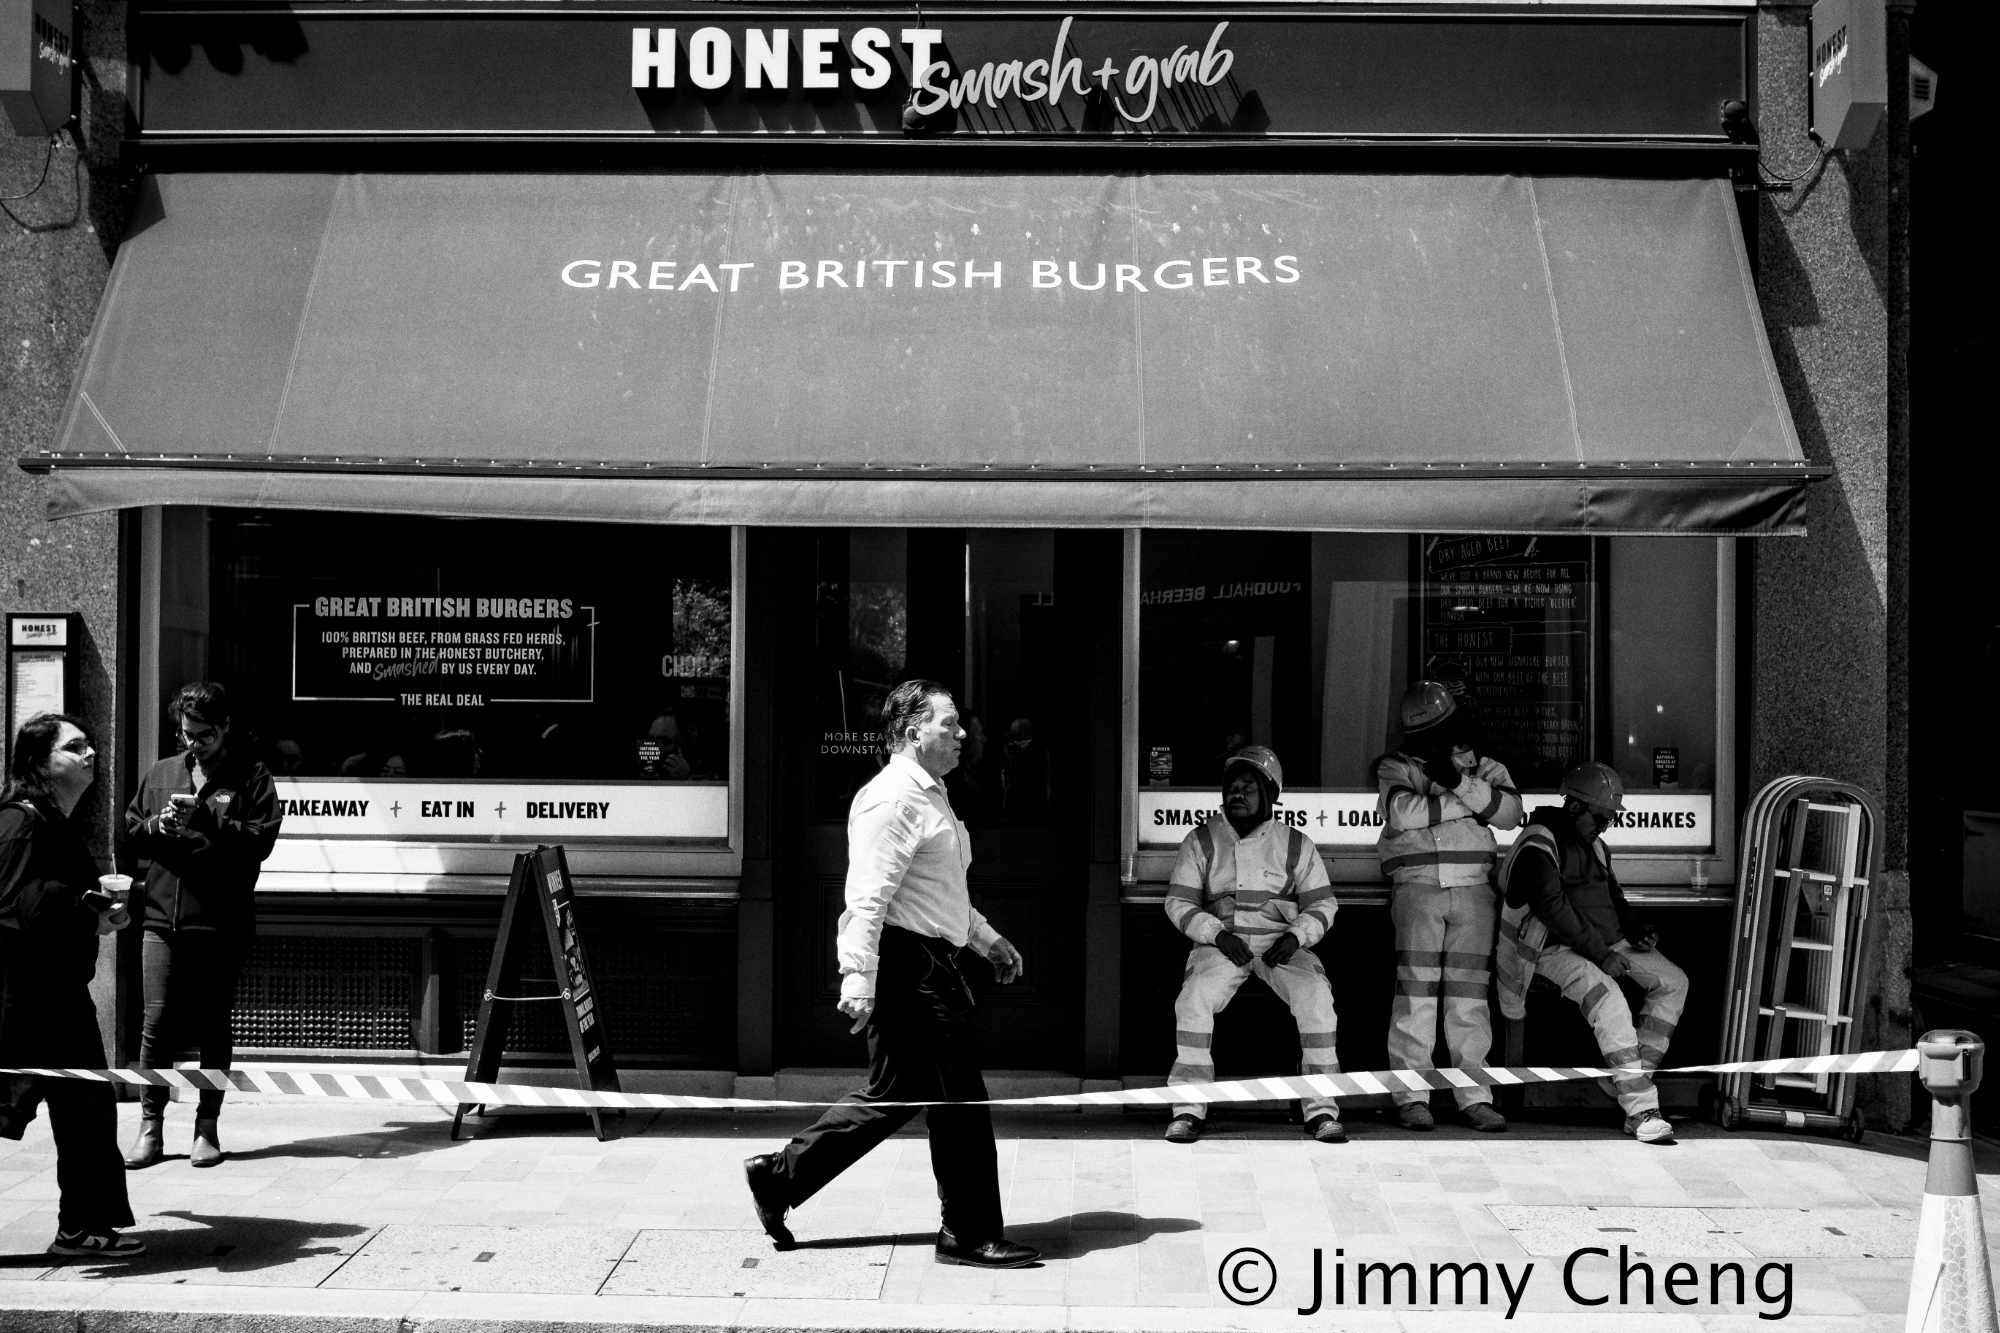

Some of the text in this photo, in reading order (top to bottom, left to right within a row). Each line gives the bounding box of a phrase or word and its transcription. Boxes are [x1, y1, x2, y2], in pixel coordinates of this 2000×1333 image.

[1816, 24, 1847, 67] HONEST
[632, 28, 942, 89] HONEST
[561, 253, 1303, 296] GREAT BRITISH BURGERS
[315, 597, 573, 619] GREAT BRITISH BURGERS
[22, 625, 56, 633] HONEST
[321, 632, 566, 645] 100% BRITISH BEEF, FROM GRASS FED HERDS,
[342, 647, 545, 661] PREPARED IN THE HONEST BUTCHERY,
[350, 662, 372, 674] AND
[442, 663, 455, 675] BY
[459, 663, 473, 675] US
[477, 664, 511, 675] EVERY
[514, 664, 537, 676] DAY.
[400, 694, 485, 707] THE REAL DEAL
[824, 732, 858, 742] MORE
[821, 745, 888, 755] DOWNSTAI
[278, 799, 369, 817] TAKEAWAY
[421, 801, 453, 818] EAT
[457, 801, 475, 818] IN
[526, 802, 610, 819] DELIVERY
[1338, 810, 1384, 827] LOAD
[1613, 811, 1696, 829] KSHAKES
